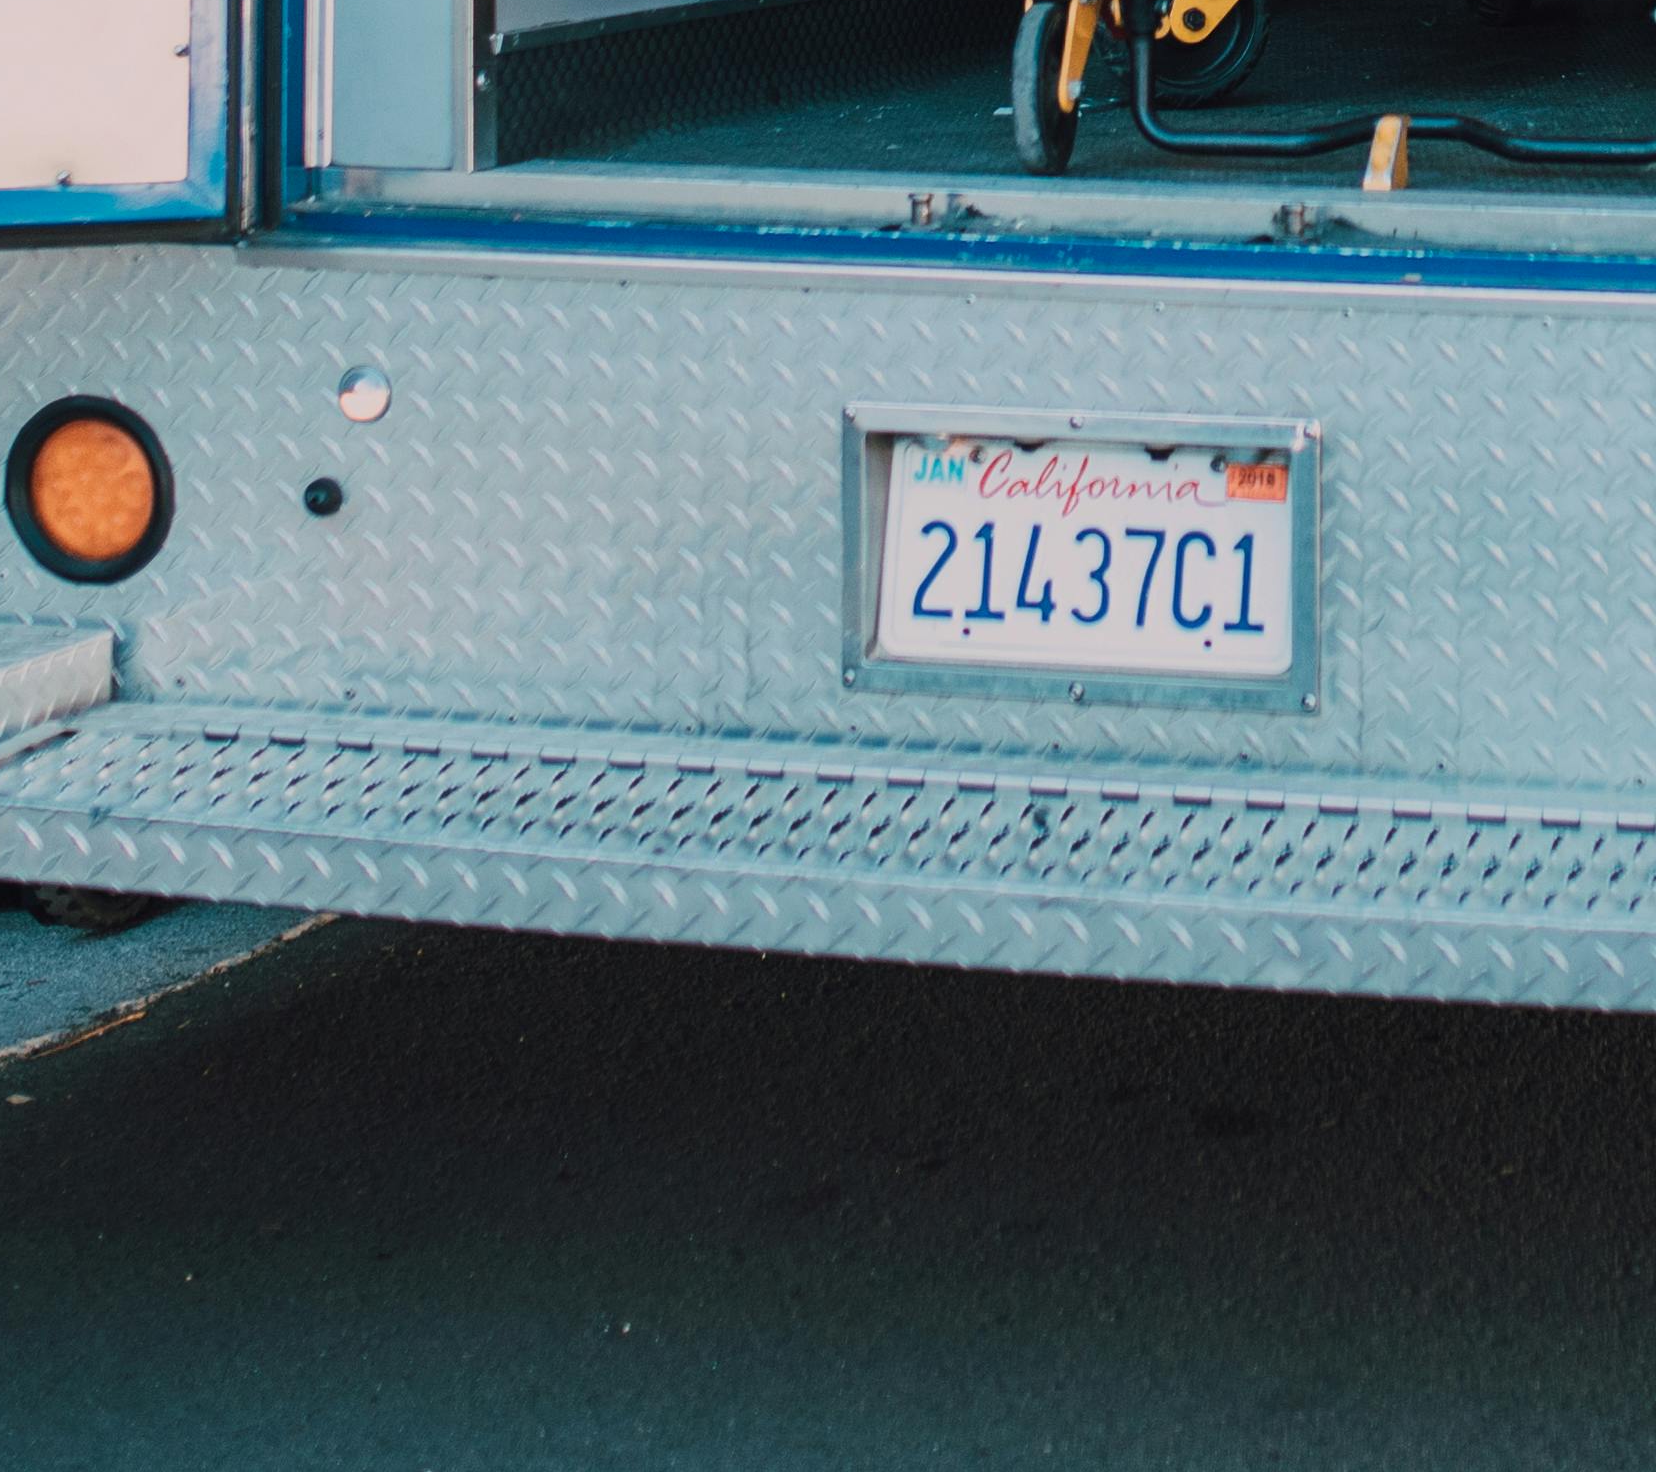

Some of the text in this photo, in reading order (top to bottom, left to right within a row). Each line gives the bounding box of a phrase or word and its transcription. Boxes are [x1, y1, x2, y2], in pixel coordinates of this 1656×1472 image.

[914, 453, 964, 482] JAN
[979, 448, 1226, 517] California
[912, 520, 1265, 632] 21437C1
